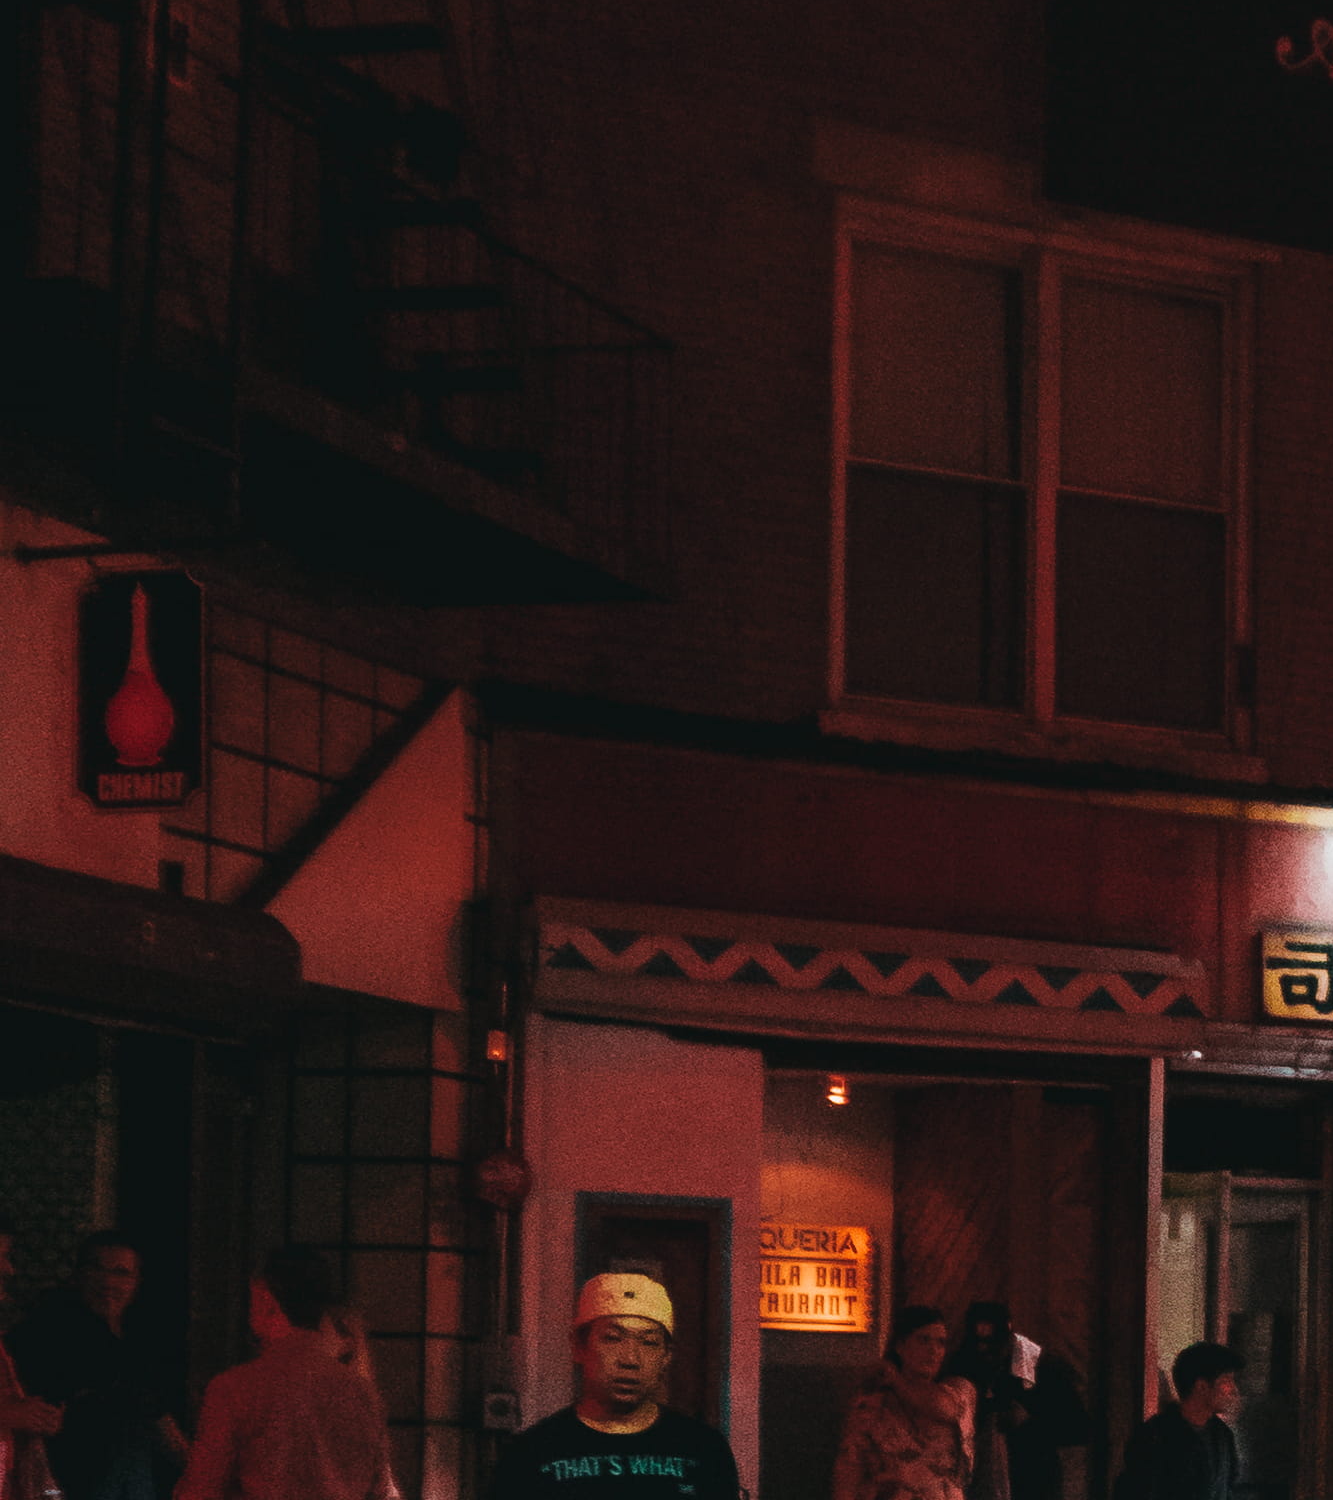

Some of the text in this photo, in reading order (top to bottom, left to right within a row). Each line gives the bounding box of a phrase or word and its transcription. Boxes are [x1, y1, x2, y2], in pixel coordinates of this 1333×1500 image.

[97, 770, 184, 802] CHEMIST
[760, 1263, 858, 1289] ILA BAR
